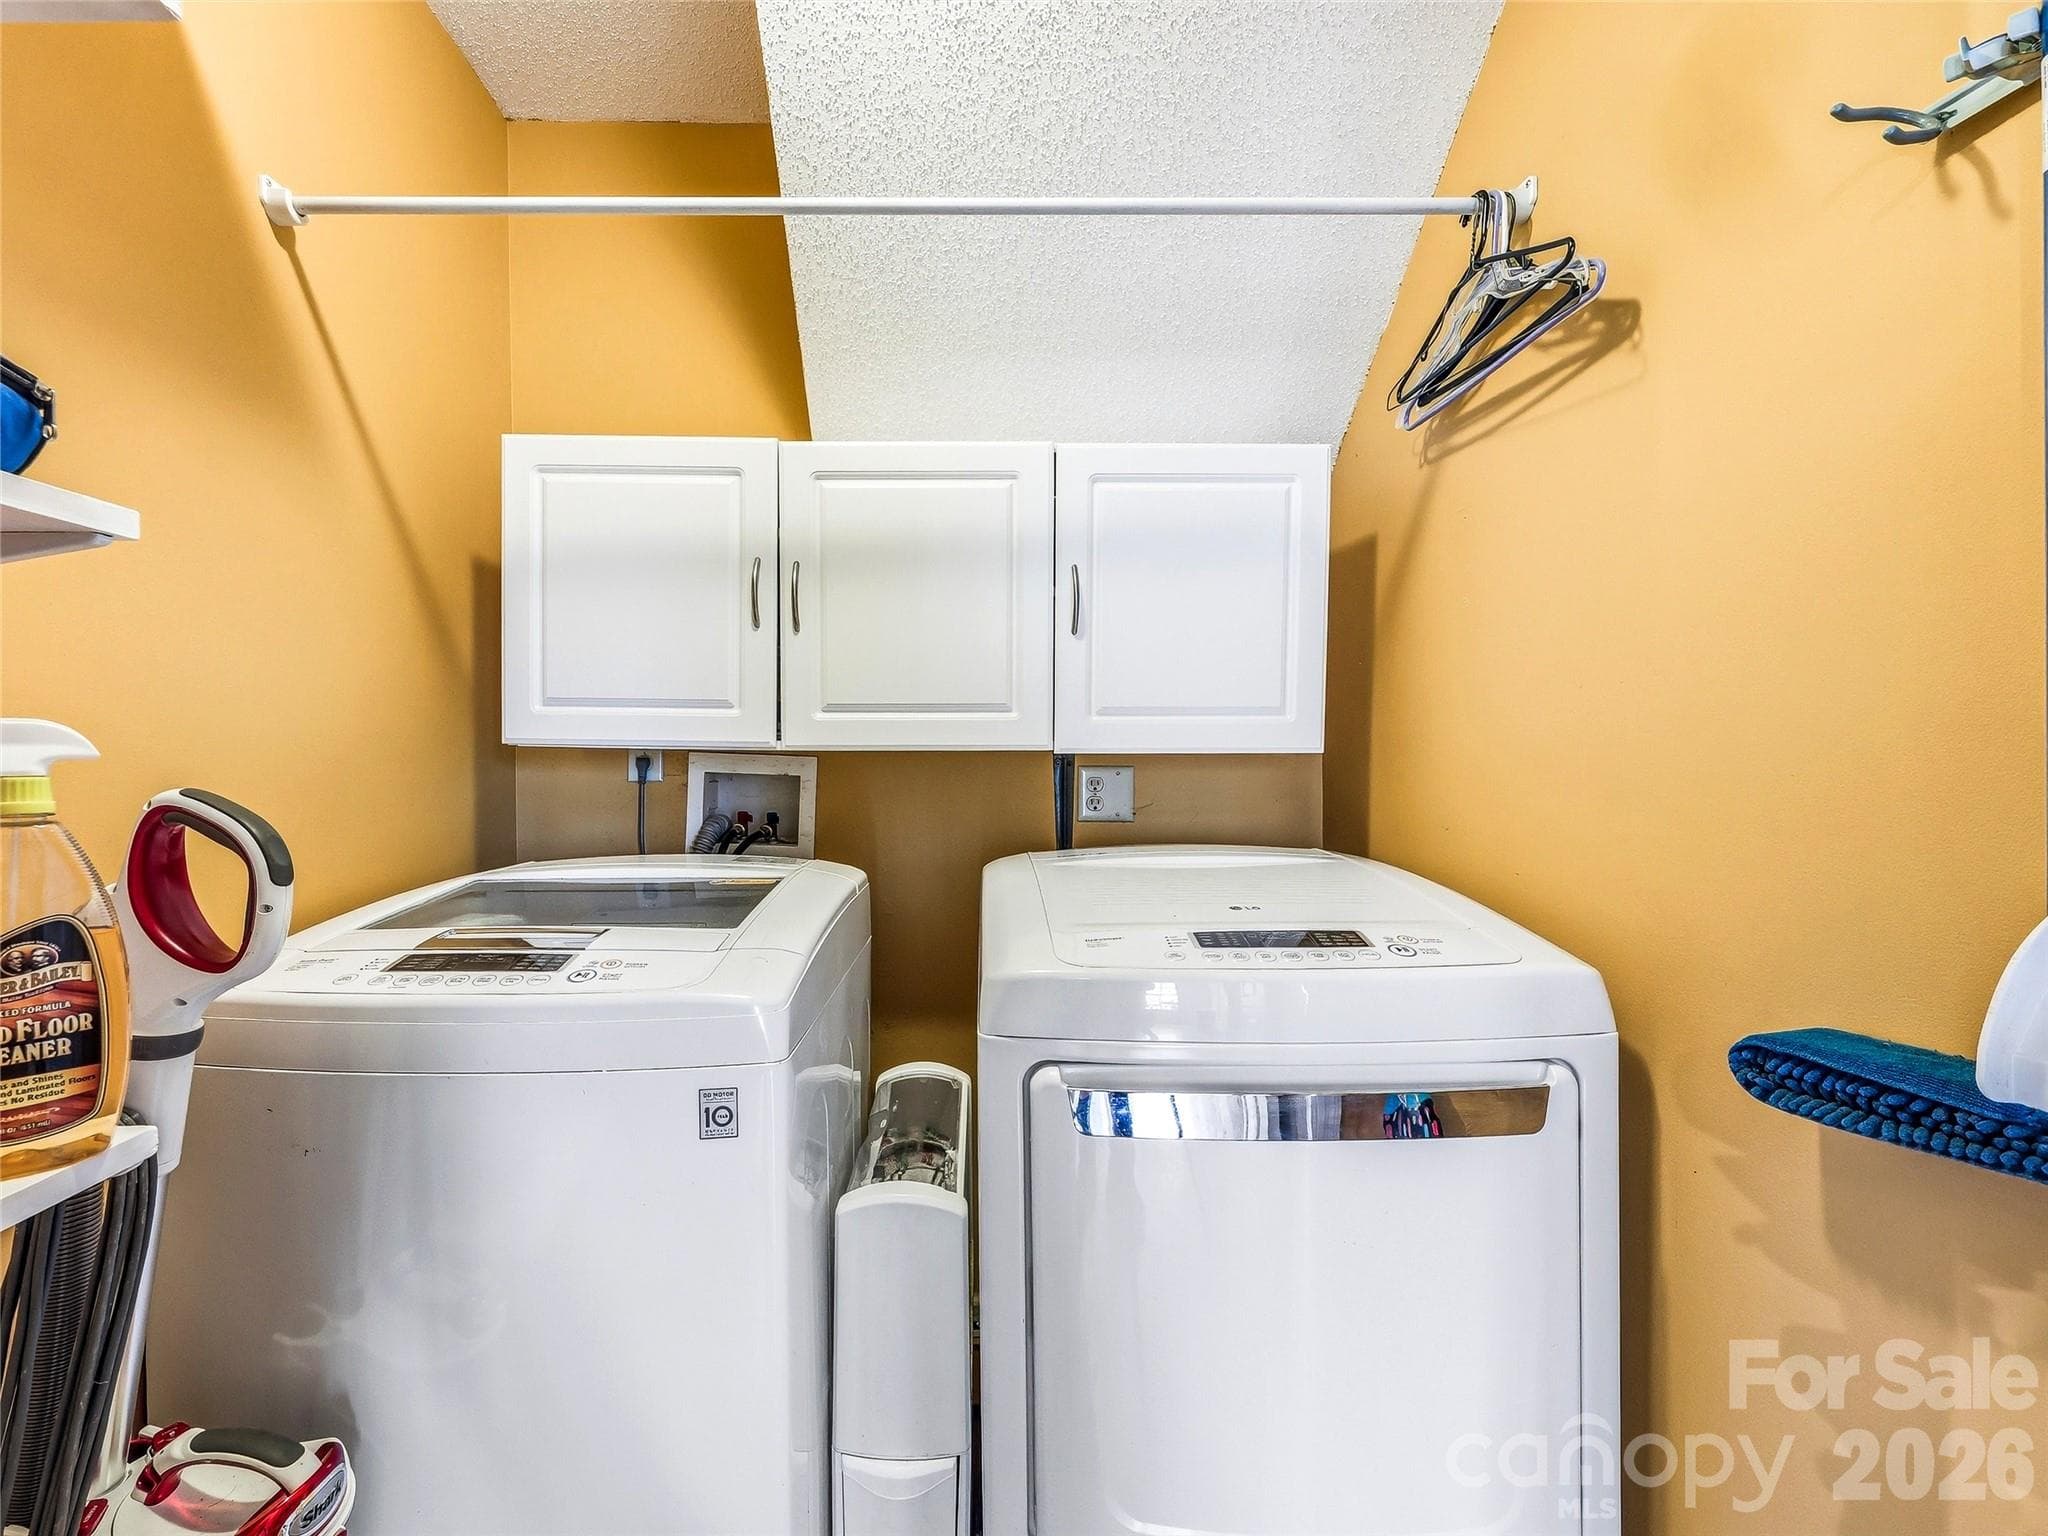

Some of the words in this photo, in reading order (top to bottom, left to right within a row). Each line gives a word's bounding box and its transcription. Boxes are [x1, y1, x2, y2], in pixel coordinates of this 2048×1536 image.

[20, 978, 29, 991] &
[31, 965, 80, 989] BAILEY
[22, 1001, 72, 1014] FORMULA
[16, 1012, 94, 1043] FLOOR
[11, 1079, 29, 1089] and
[32, 1073, 65, 1085] Shines
[16, 1080, 66, 1096] Laminated
[69, 1074, 97, 1085] Floors
[11, 1097, 25, 1105] No
[28, 1088, 66, 1101] Residue
[704, 1105, 734, 1128] 10
[300, 1479, 342, 1529] Shark
